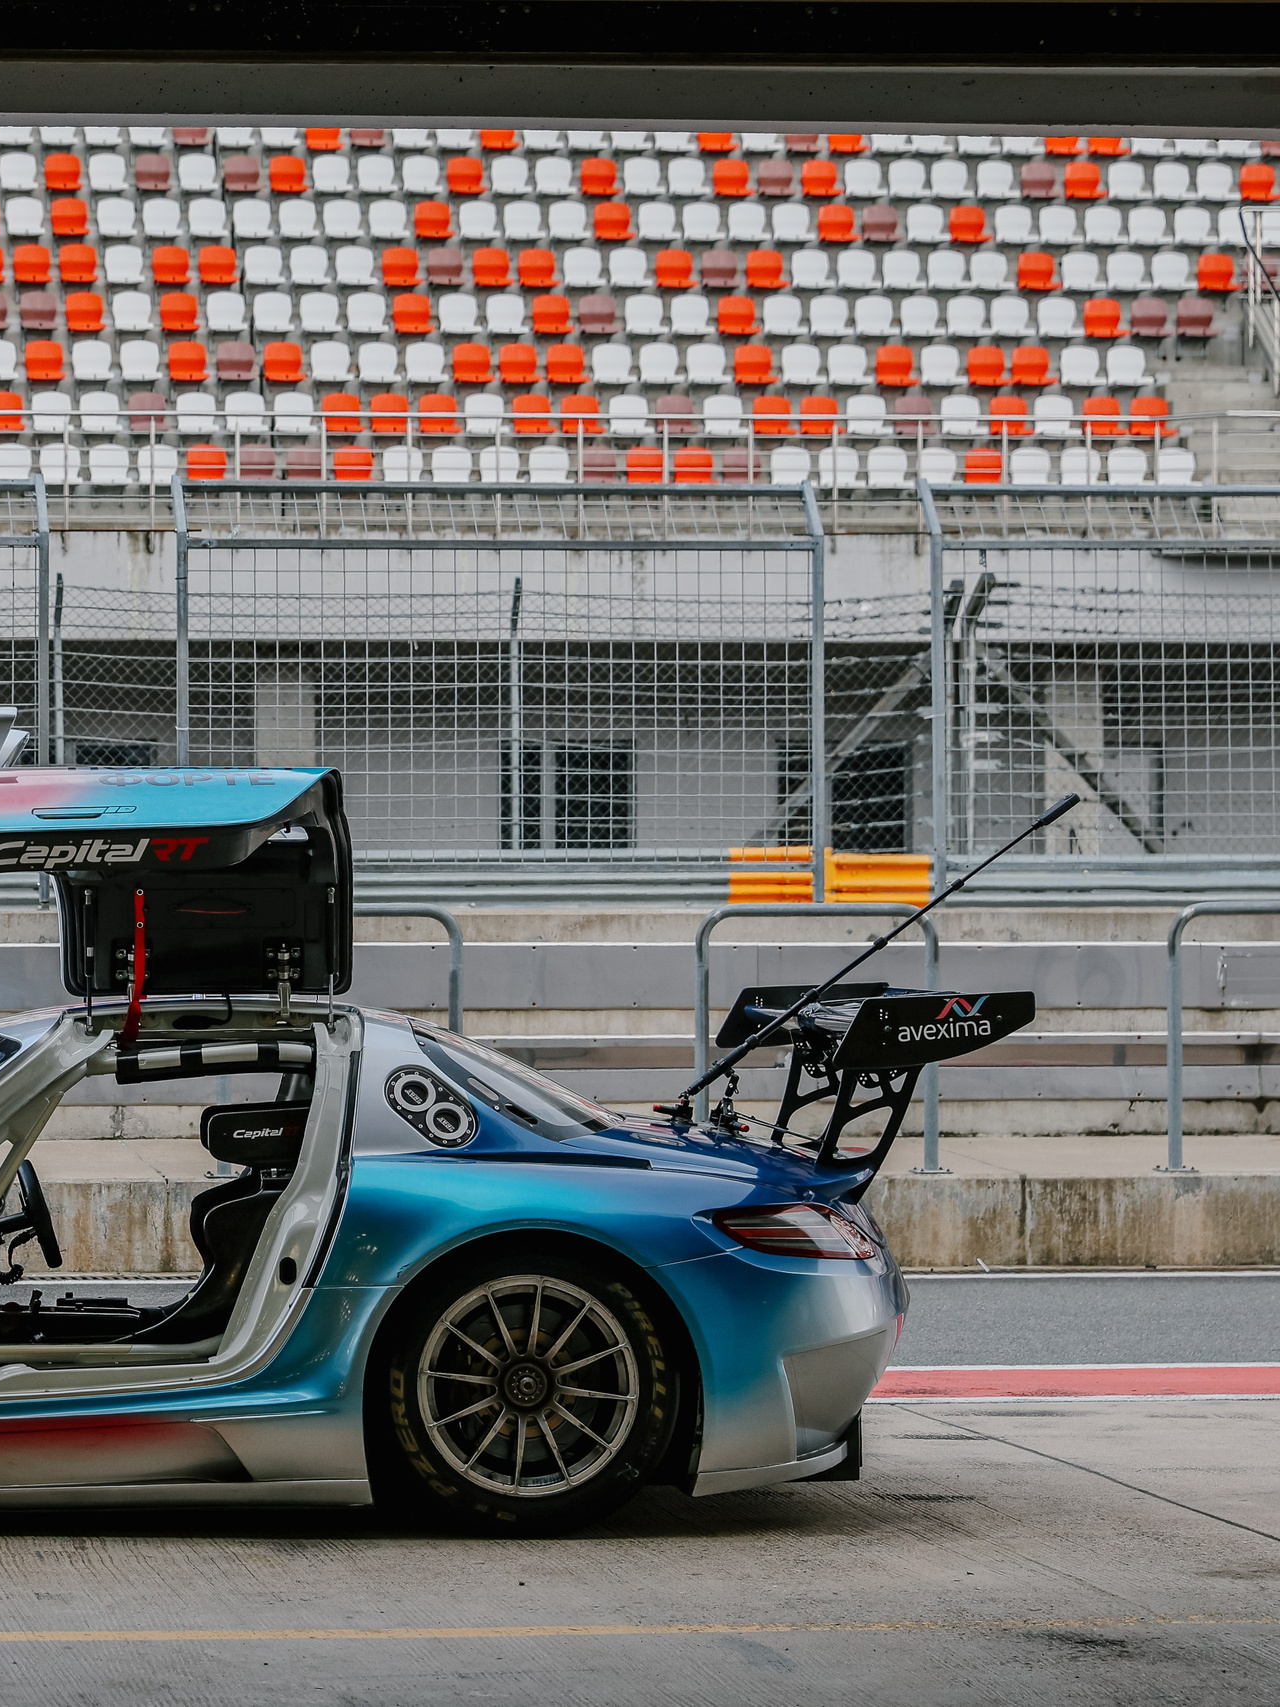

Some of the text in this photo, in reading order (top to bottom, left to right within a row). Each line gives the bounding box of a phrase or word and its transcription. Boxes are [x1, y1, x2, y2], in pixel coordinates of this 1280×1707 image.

[98, 772, 276, 787] ФОРТЕ
[898, 1017, 991, 1042] avexima
[605, 1282, 666, 1420] PIRELLI
